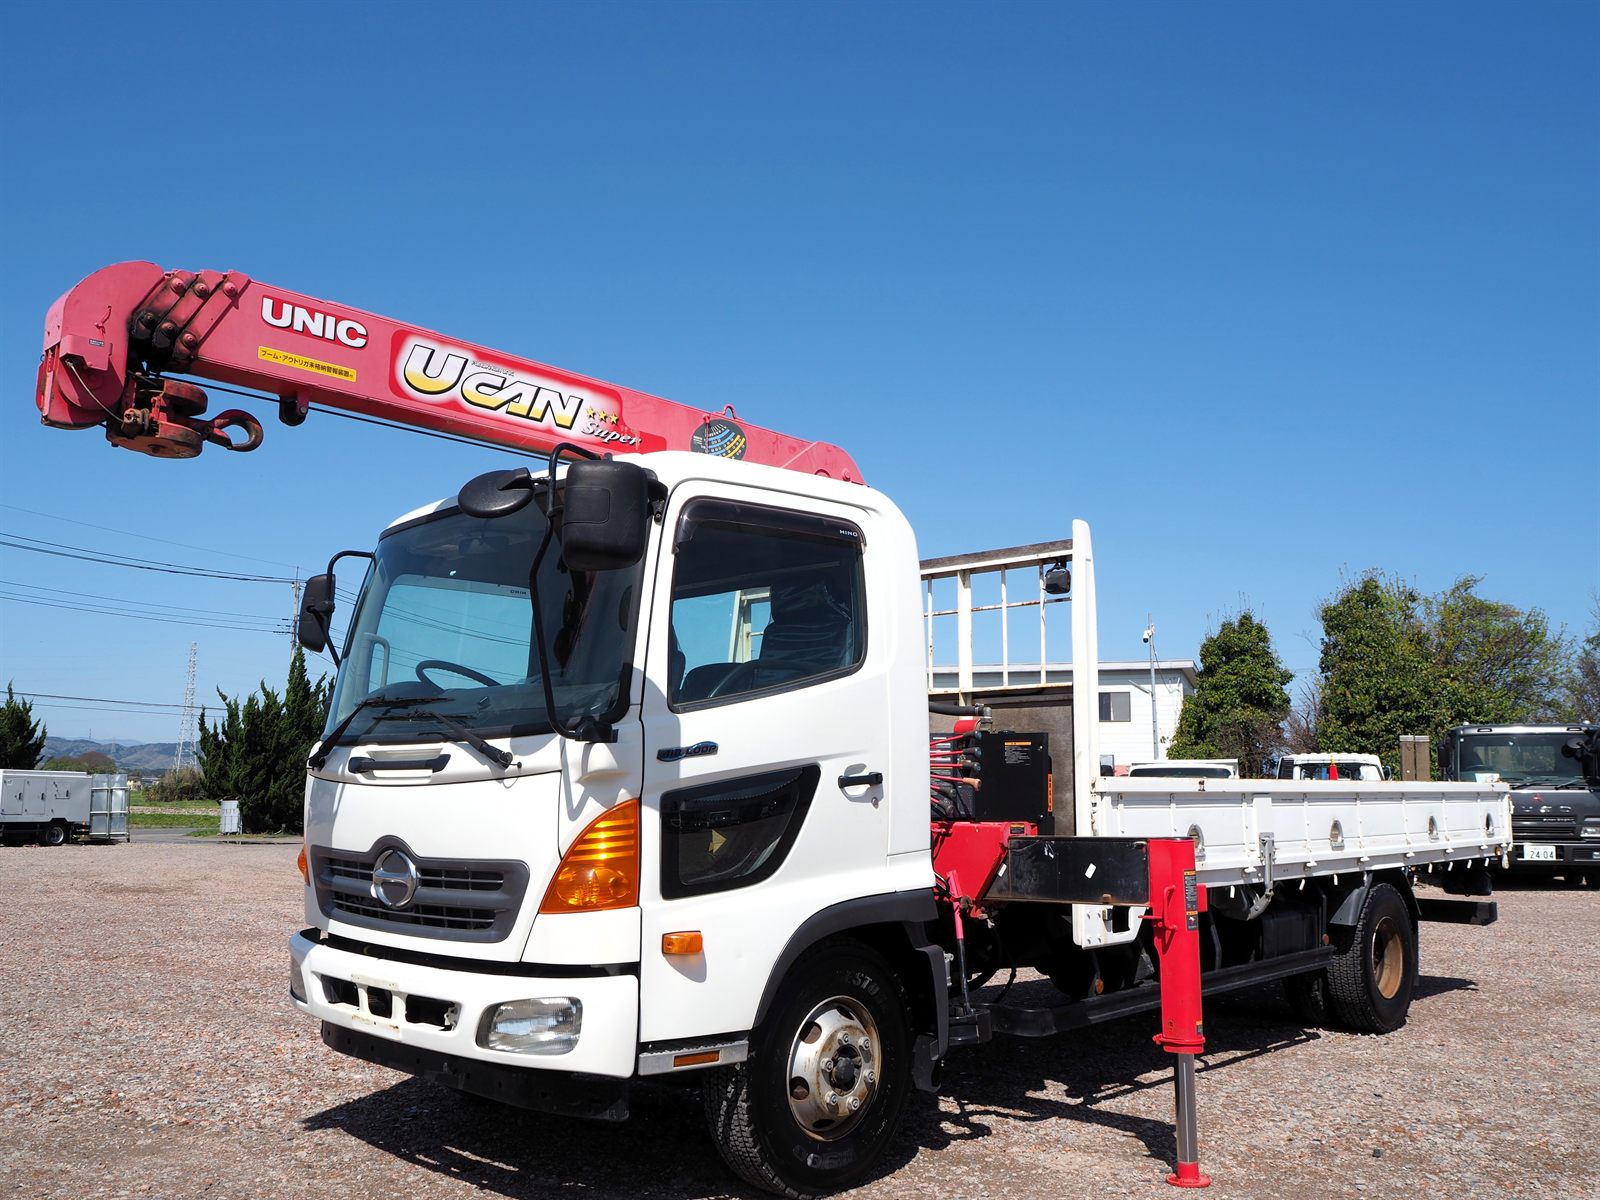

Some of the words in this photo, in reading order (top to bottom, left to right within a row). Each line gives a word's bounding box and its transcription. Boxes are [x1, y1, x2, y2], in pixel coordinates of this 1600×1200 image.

[261, 297, 368, 349] UNIC
[403, 343, 583, 430] UCAN
[582, 421, 642, 447] Super
[839, 529, 858, 537] HINO
